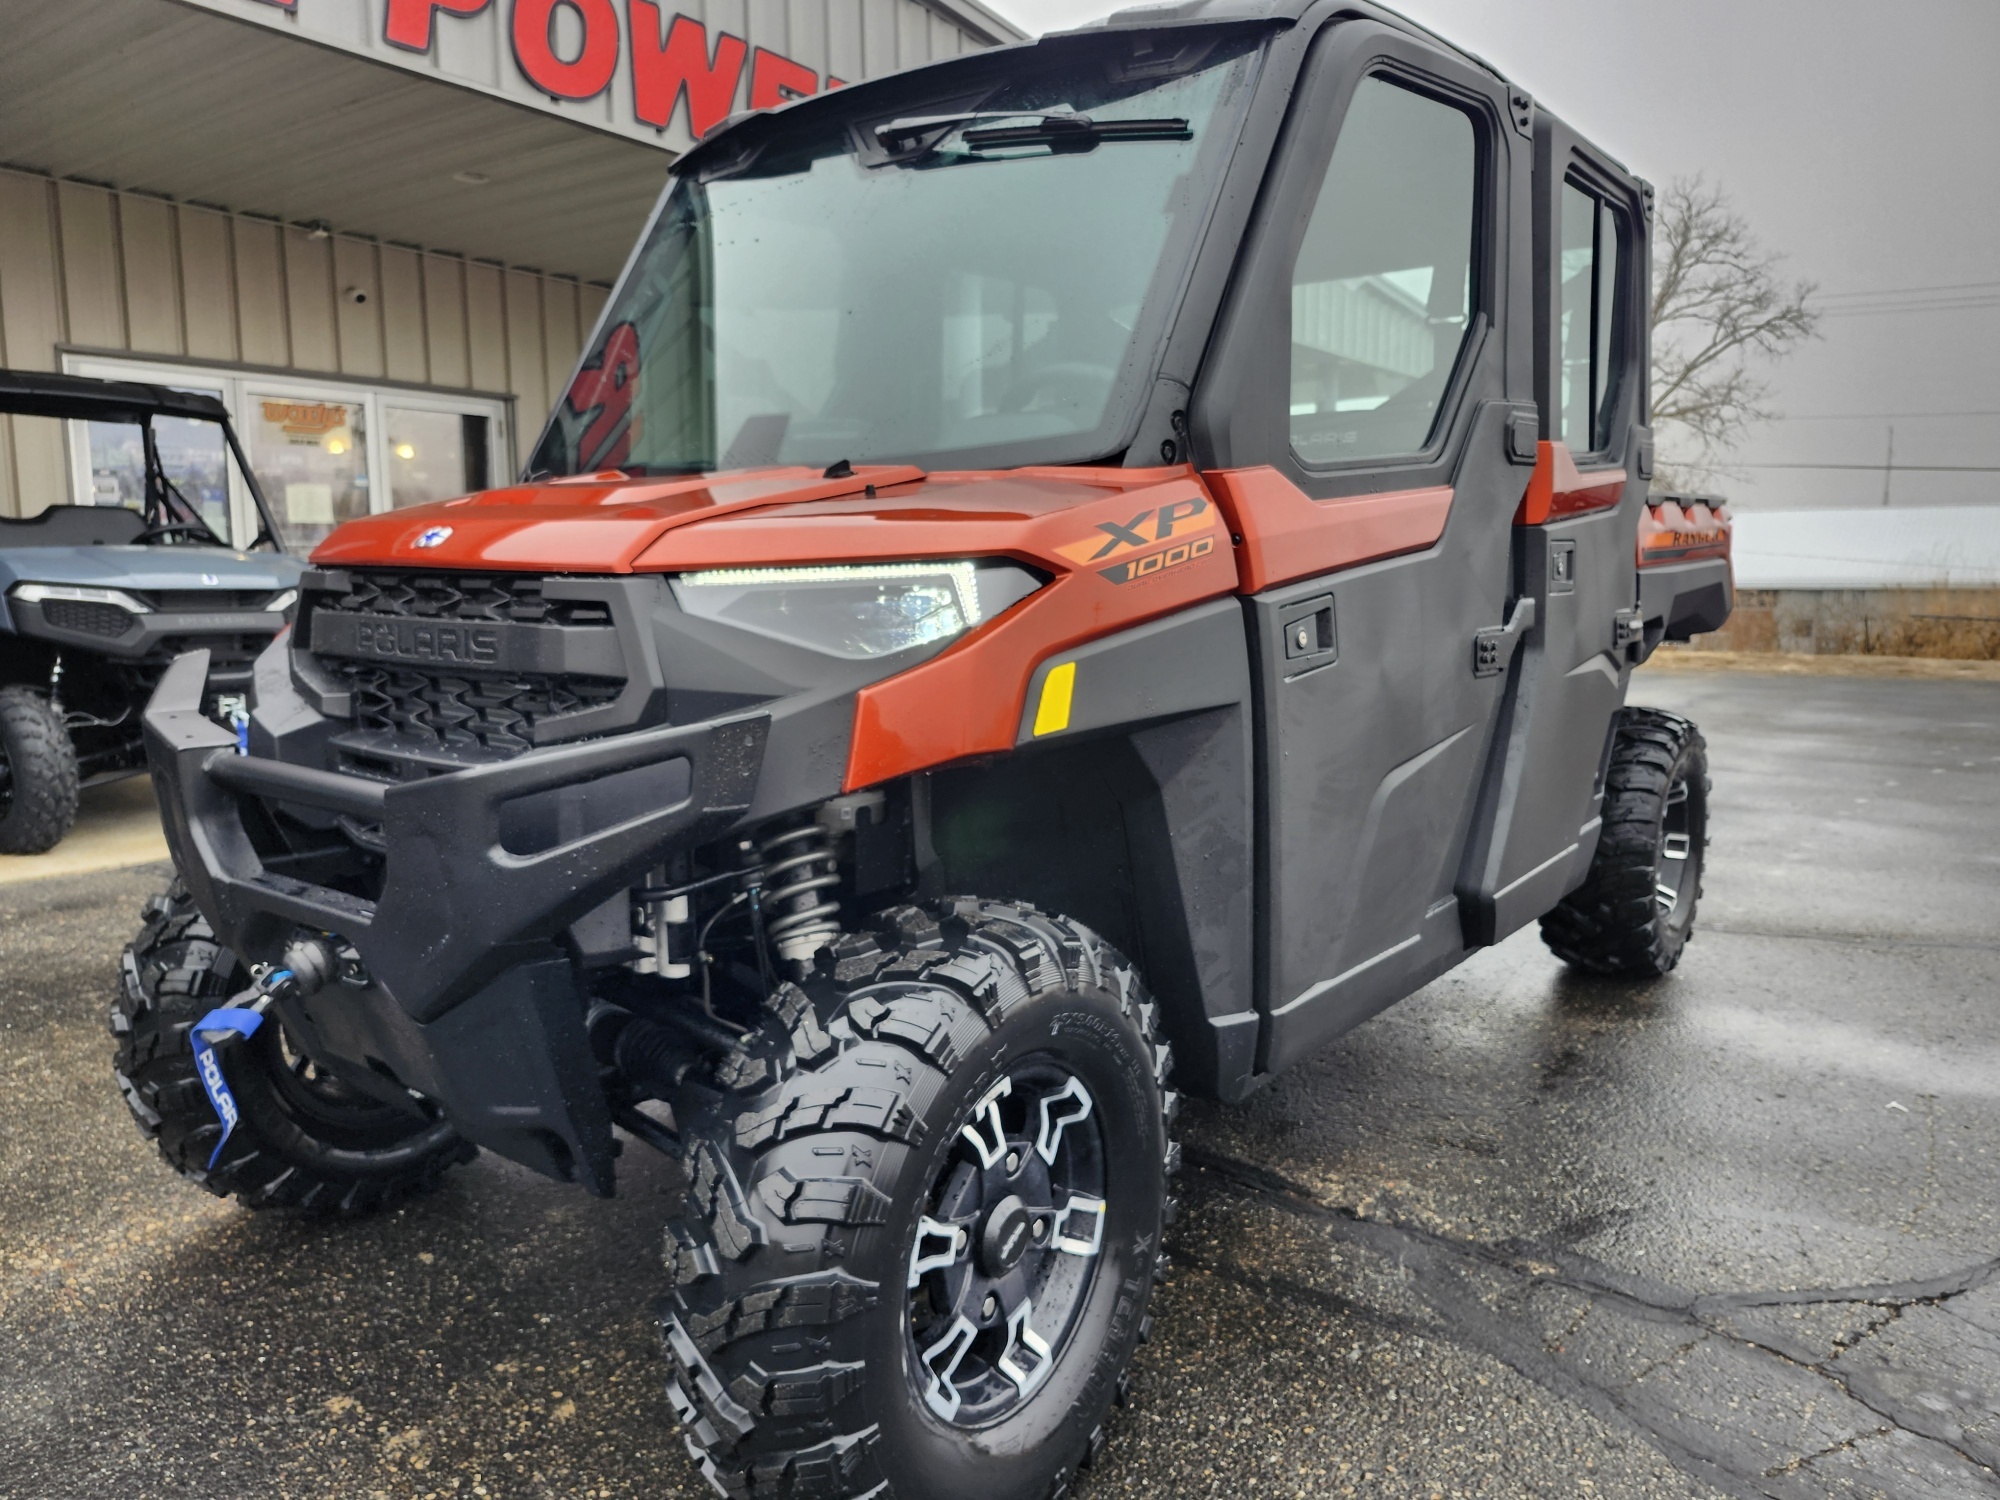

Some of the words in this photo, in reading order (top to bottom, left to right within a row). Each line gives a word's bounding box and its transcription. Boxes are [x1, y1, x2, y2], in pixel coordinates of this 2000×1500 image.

[1290, 431, 1358, 446] OLARIS
[1088, 496, 1208, 562] XP
[1126, 536, 1214, 580] 1000
[357, 621, 497, 665] POLARIS
[198, 1047, 239, 1131] POLAR
